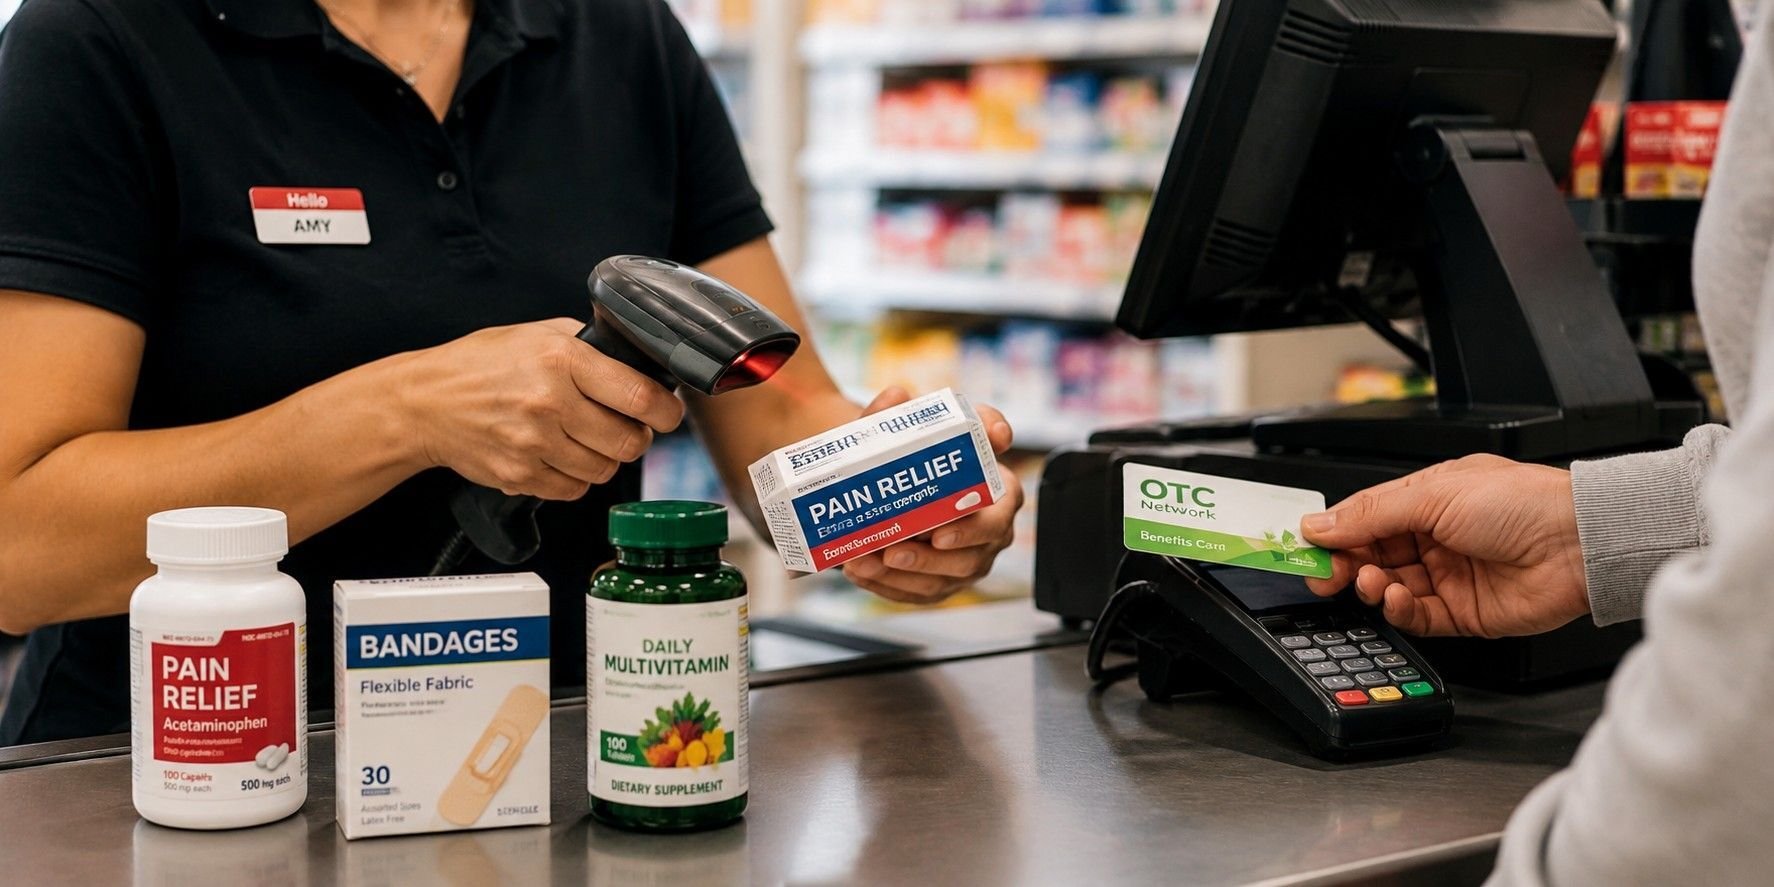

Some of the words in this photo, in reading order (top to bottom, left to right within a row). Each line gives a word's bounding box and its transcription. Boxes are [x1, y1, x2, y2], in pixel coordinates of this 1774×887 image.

[286, 192, 328, 208] Hello
[294, 219, 331, 232] AMY
[809, 485, 874, 525] PAIN
[876, 449, 963, 499] RELIEF
[1140, 479, 1216, 508] OTC
[1141, 500, 1216, 520] Network
[1140, 530, 1193, 547] Benefits
[360, 628, 519, 659] BANDAGES
[643, 638, 693, 654] DAILY
[162, 655, 229, 681] PAIN
[605, 654, 729, 675] MULTIVITAMIN
[360, 678, 421, 694] Flexible
[426, 675, 474, 691] Fabric
[163, 684, 258, 710] RELIEF
[163, 717, 268, 733] Acetaminophen
[606, 737, 627, 752] 100
[164, 770, 179, 780] 100
[241, 778, 260, 790] 500
[361, 766, 390, 785] 30
[611, 779, 652, 794] DIETARY
[655, 779, 723, 796] SUPPLEMENT
